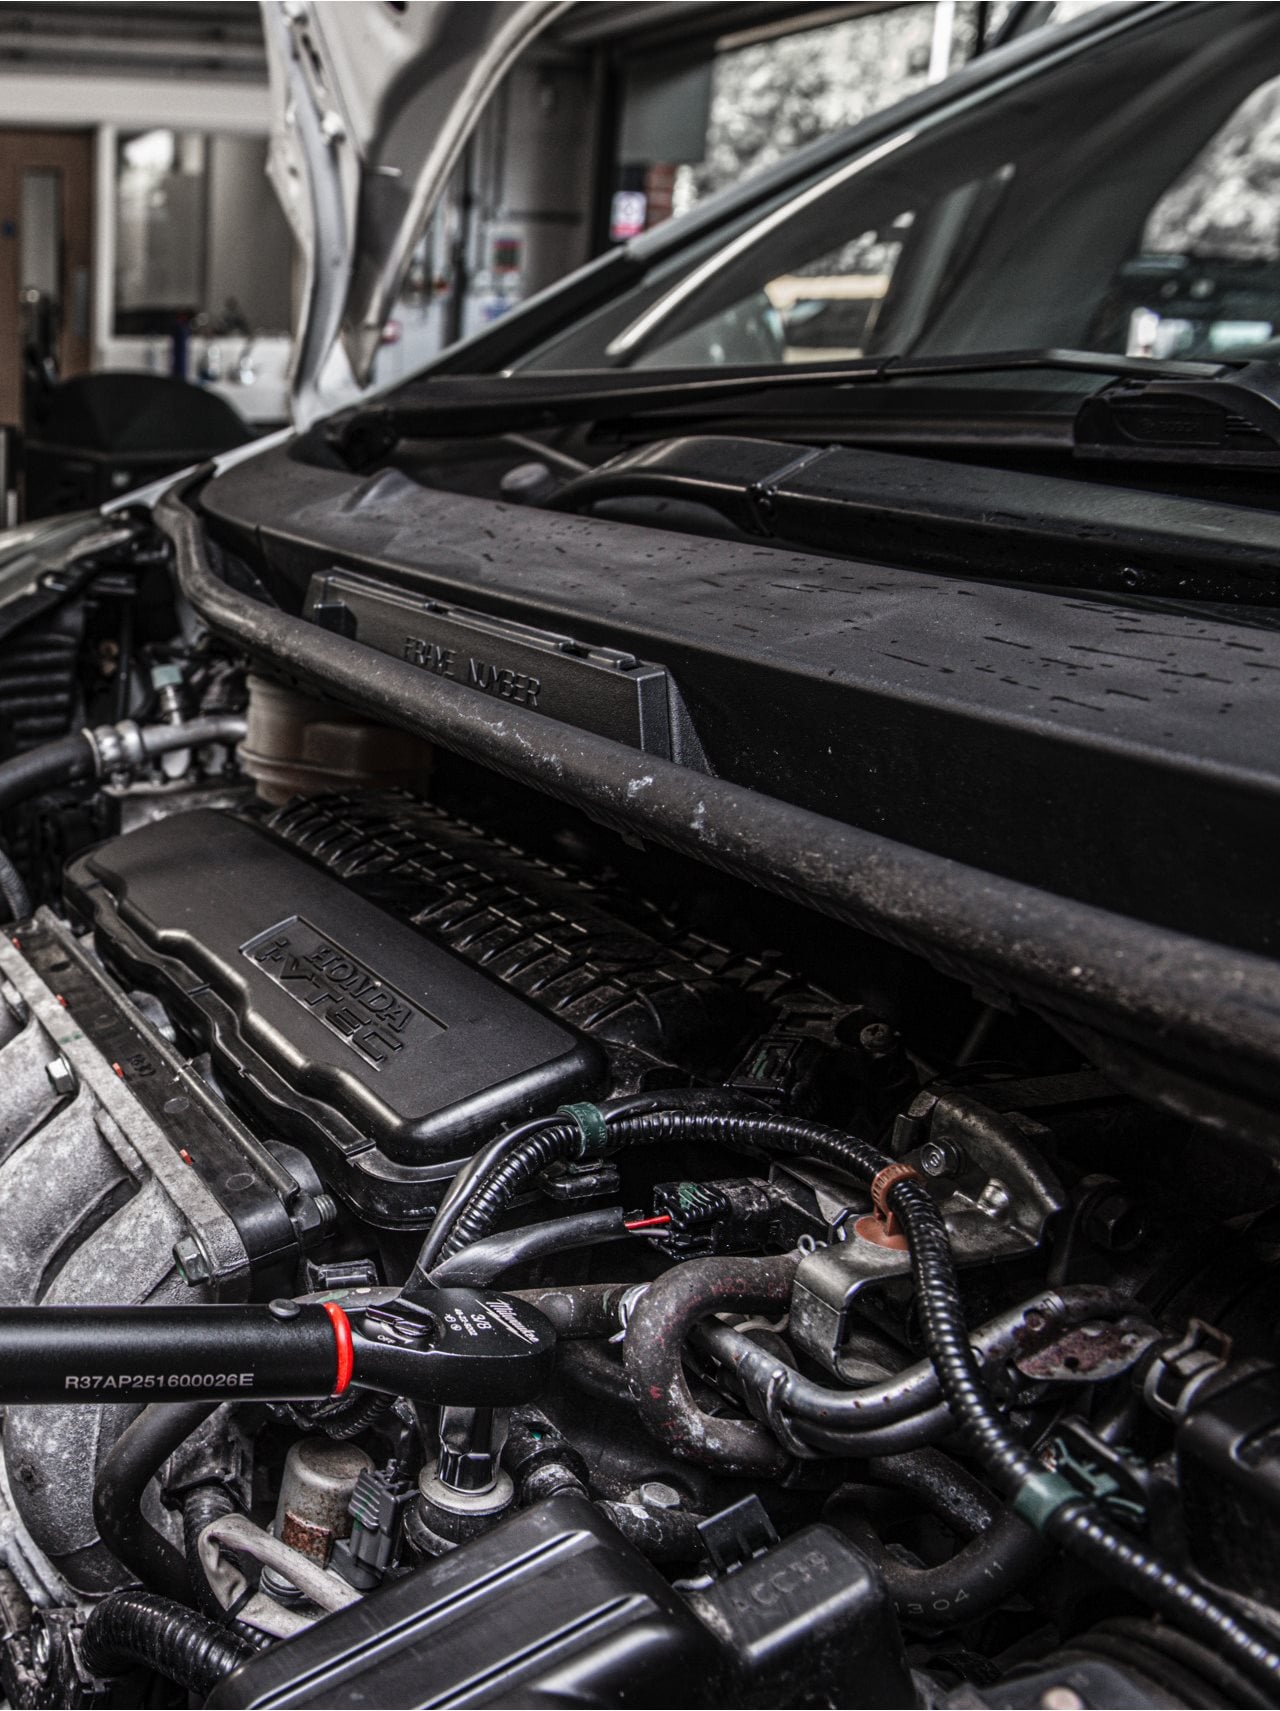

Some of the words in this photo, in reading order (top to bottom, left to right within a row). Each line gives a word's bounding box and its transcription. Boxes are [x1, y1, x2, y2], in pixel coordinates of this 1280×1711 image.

[403, 635, 457, 677] FRAME
[468, 657, 542, 707] NUMBER
[303, 946, 413, 1033] HONDA
[470, 1313, 492, 1330] 3/8
[485, 1298, 540, 1343] Milwaukee
[64, 1372, 255, 1390] R37AP251600026E
